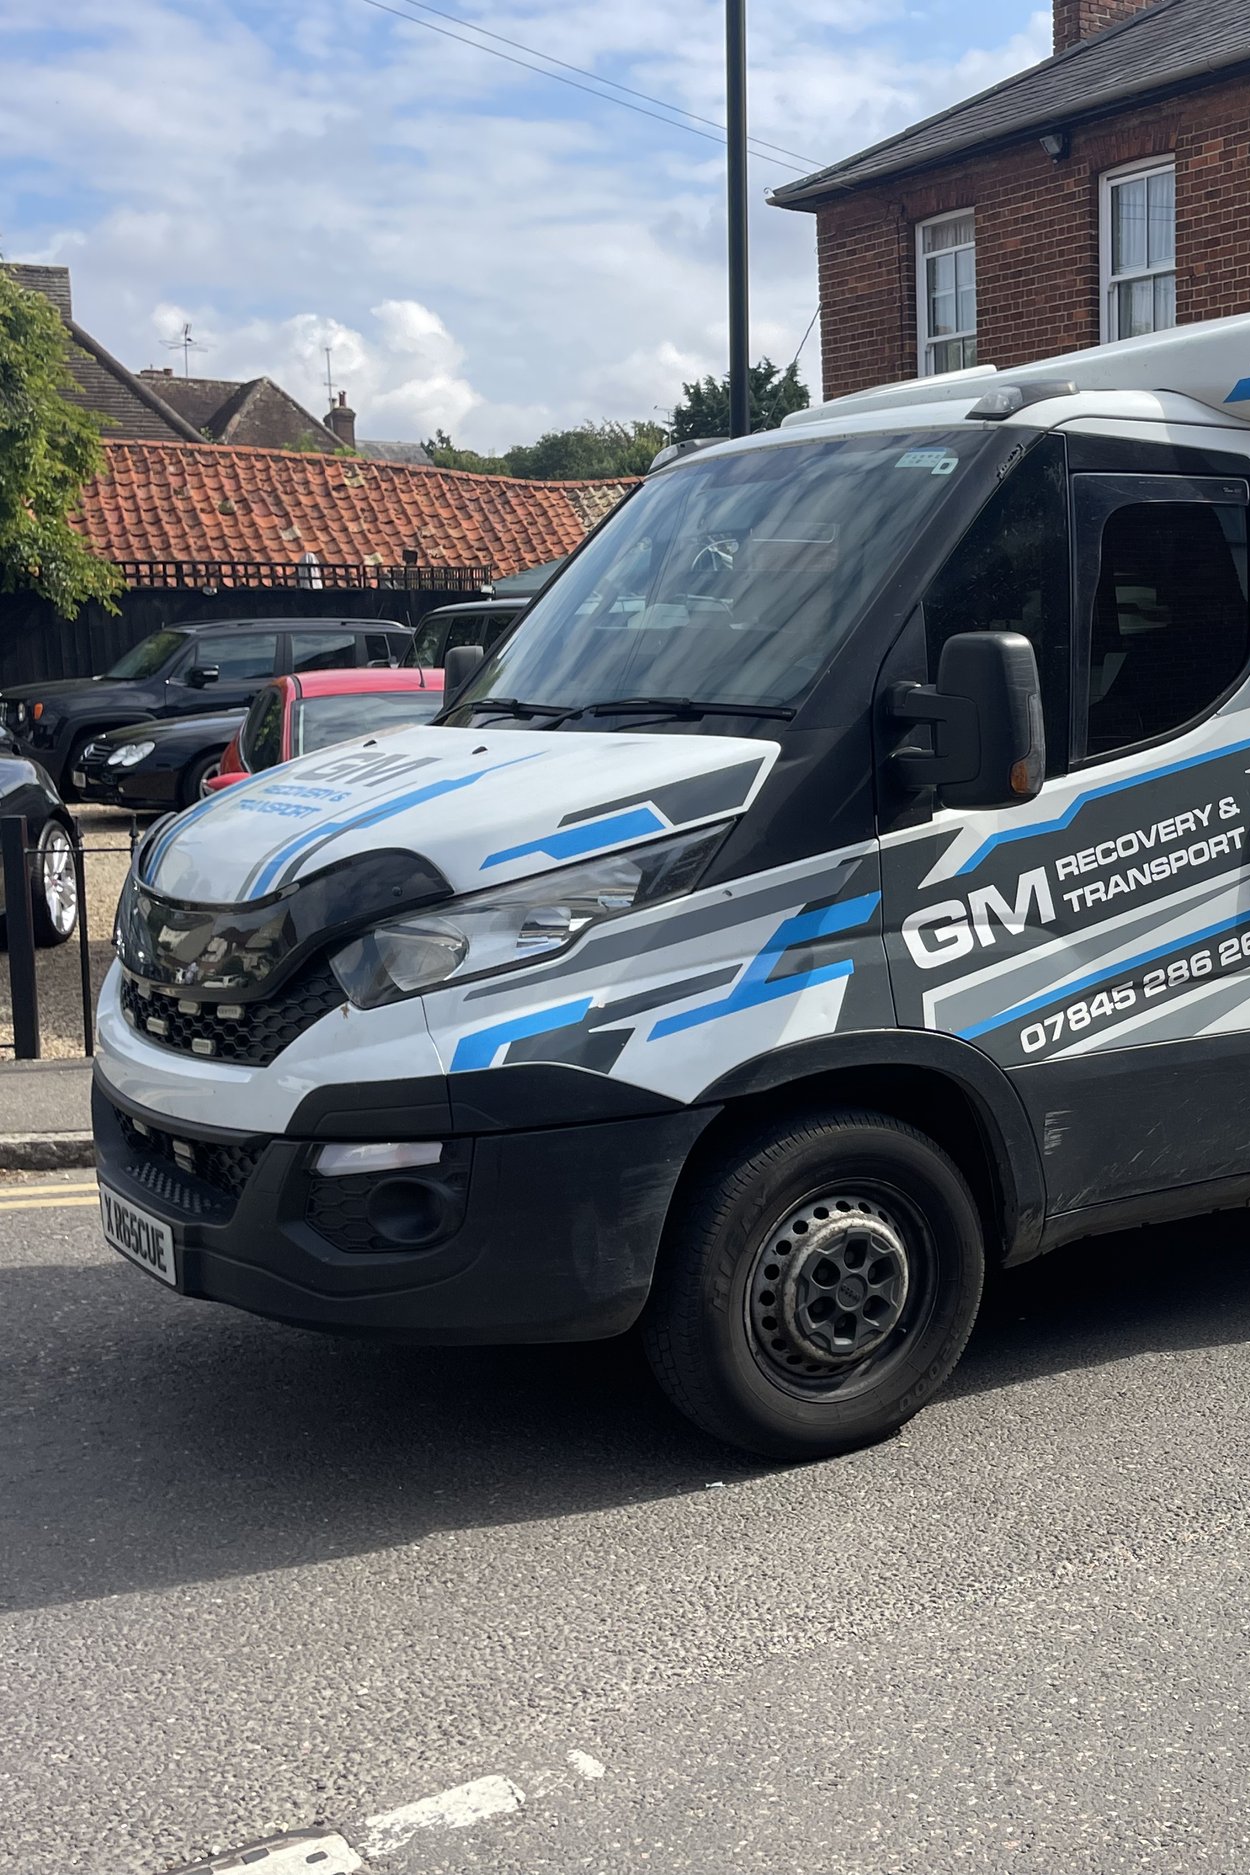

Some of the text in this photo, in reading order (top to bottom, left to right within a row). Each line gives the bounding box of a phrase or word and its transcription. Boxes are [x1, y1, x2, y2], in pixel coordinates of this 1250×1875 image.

[294, 752, 443, 787] GM
[1055, 796, 1241, 881] RECOVERY &
[1063, 826, 1246, 913] TRANSPORT
[901, 865, 1056, 970] GM
[1020, 980, 1138, 1054] 07845
[1143, 950, 1213, 998] 286
